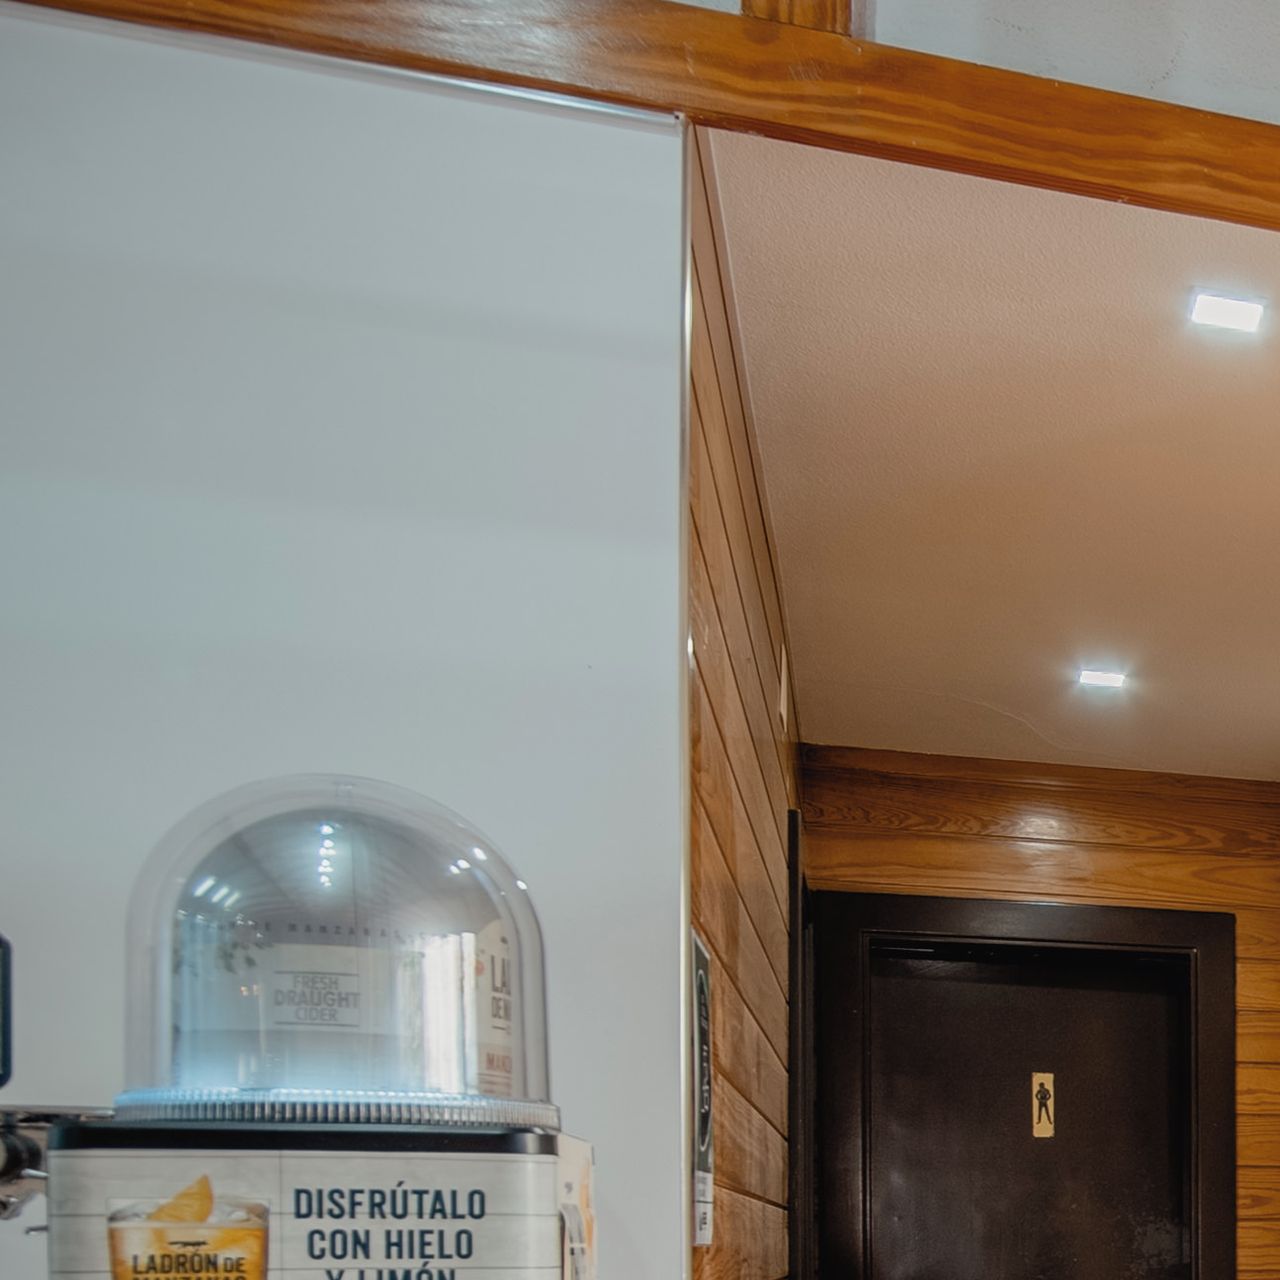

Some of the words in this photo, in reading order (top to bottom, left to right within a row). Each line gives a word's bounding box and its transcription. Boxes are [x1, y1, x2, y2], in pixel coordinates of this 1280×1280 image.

[293, 975, 339, 990] FRESH
[274, 989, 362, 1008] DRAUGHT
[295, 1007, 338, 1022] CIDER
[293, 1180, 486, 1219] DISFRÚTALO
[307, 1229, 370, 1260] CON
[384, 1229, 473, 1260] HIELO
[132, 1249, 219, 1274] LADRÓN
[223, 1257, 246, 1273] DE
